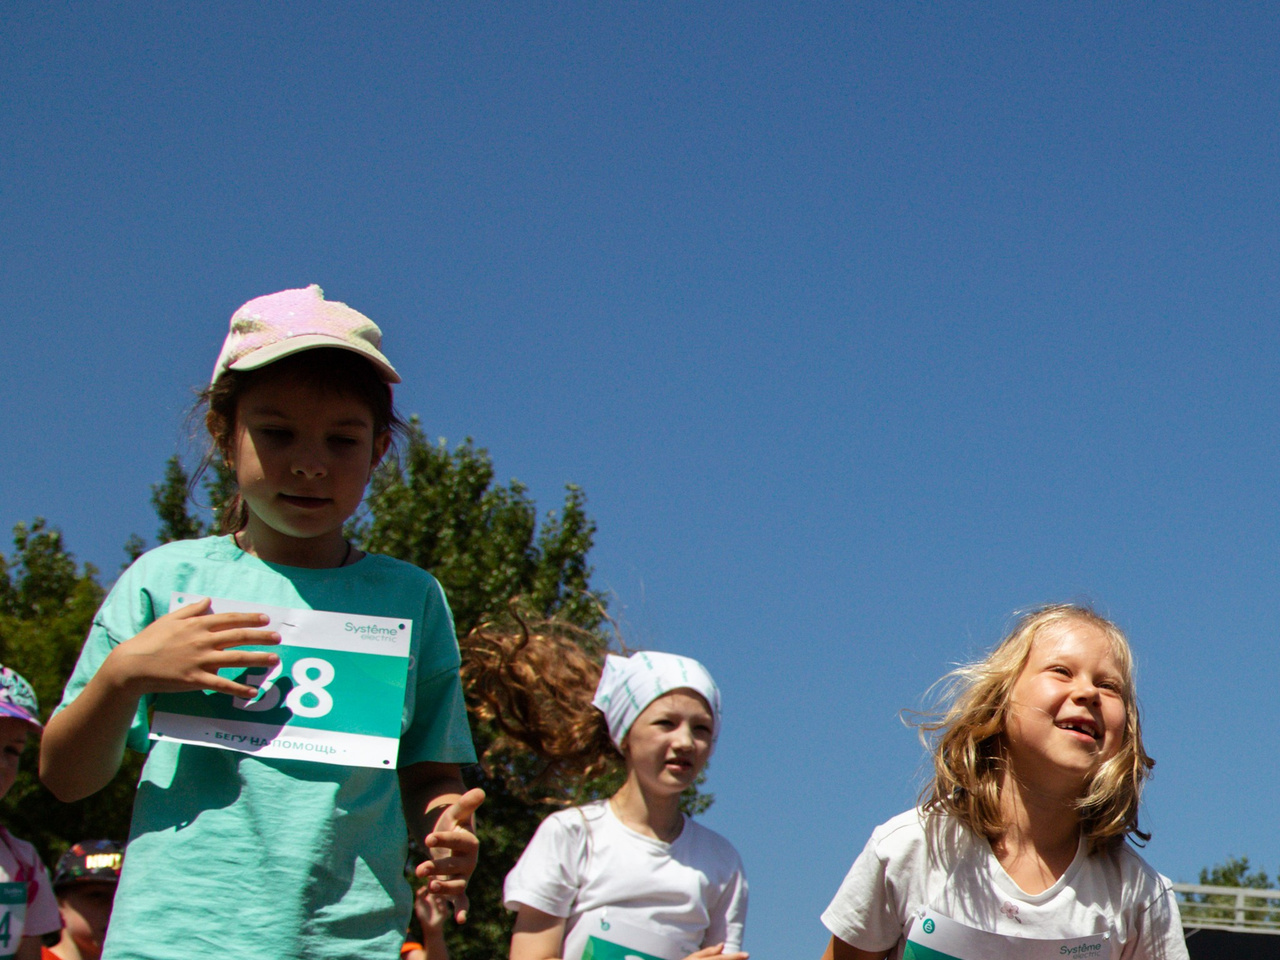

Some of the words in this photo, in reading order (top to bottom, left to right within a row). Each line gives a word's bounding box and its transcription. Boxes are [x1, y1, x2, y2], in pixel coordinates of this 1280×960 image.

[344, 621, 398, 636] Système
[360, 634, 397, 643] electric
[214, 731, 248, 743] БЕГУ
[249, 737, 269, 747] НА
[272, 739, 337, 755] ПОМОЩЬ
[1059, 943, 1102, 956] Système
[1072, 951, 1101, 960] electric
